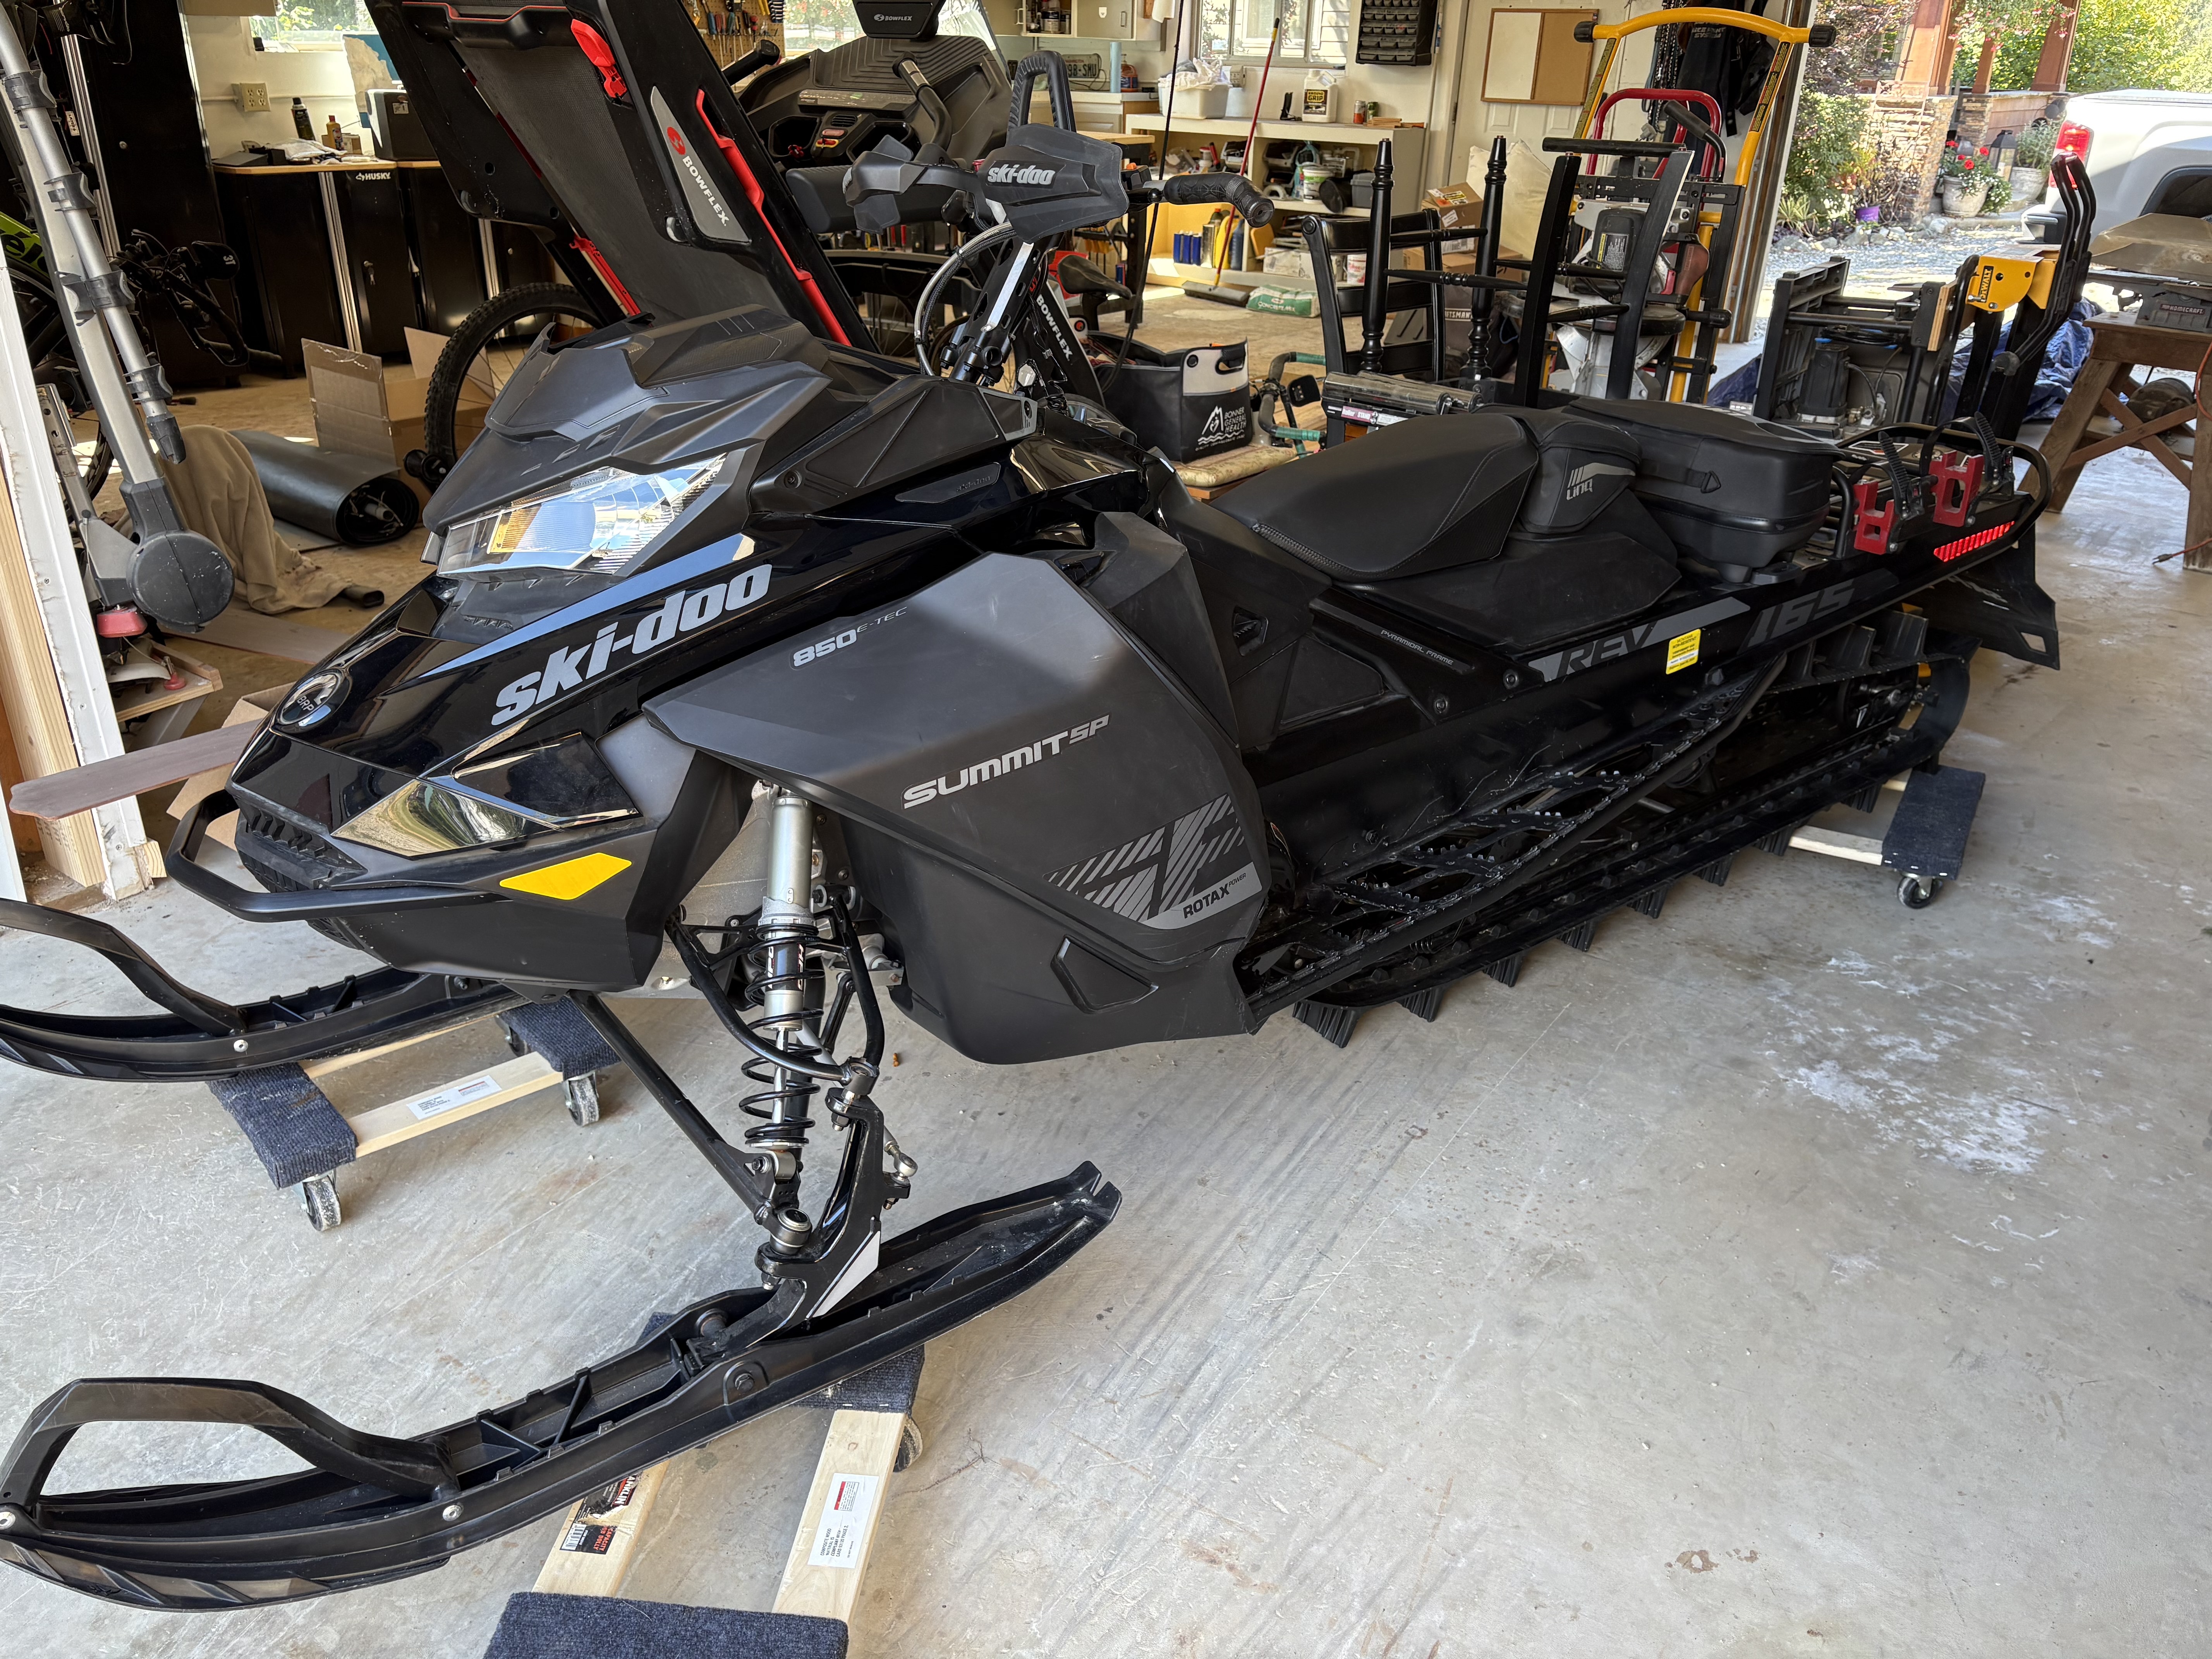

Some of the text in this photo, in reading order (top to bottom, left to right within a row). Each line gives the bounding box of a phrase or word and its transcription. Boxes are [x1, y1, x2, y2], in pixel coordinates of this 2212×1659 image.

[365, 172, 391, 180] HUSKY
[988, 164, 1056, 185] ski-doo
[682, 156, 729, 225] BOWFLEX
[2169, 306, 2203, 314] HOMECRAFT
[1036, 294, 1073, 359] BOWFLEX
[1224, 407, 1245, 419] BONNER
[1224, 413, 1246, 426] GENERAL
[1225, 420, 1246, 433] HEALTH
[1747, 578, 1855, 648] 165
[491, 564, 773, 726] ski-doo
[793, 606, 907, 666] 850 E-TEC
[1381, 629, 1454, 665] PYRAMIDAL FRAME
[1556, 621, 1658, 679] REV
[297, 696, 314, 711] BRP
[904, 714, 1109, 809] SUMMIT SP
[1183, 873, 1246, 919] ROTAX POWER
[614, 1476, 635, 1504] ANKLIN
[593, 1535, 603, 1551] DOLLY
[599, 1528, 613, 1551] CAPACITY
